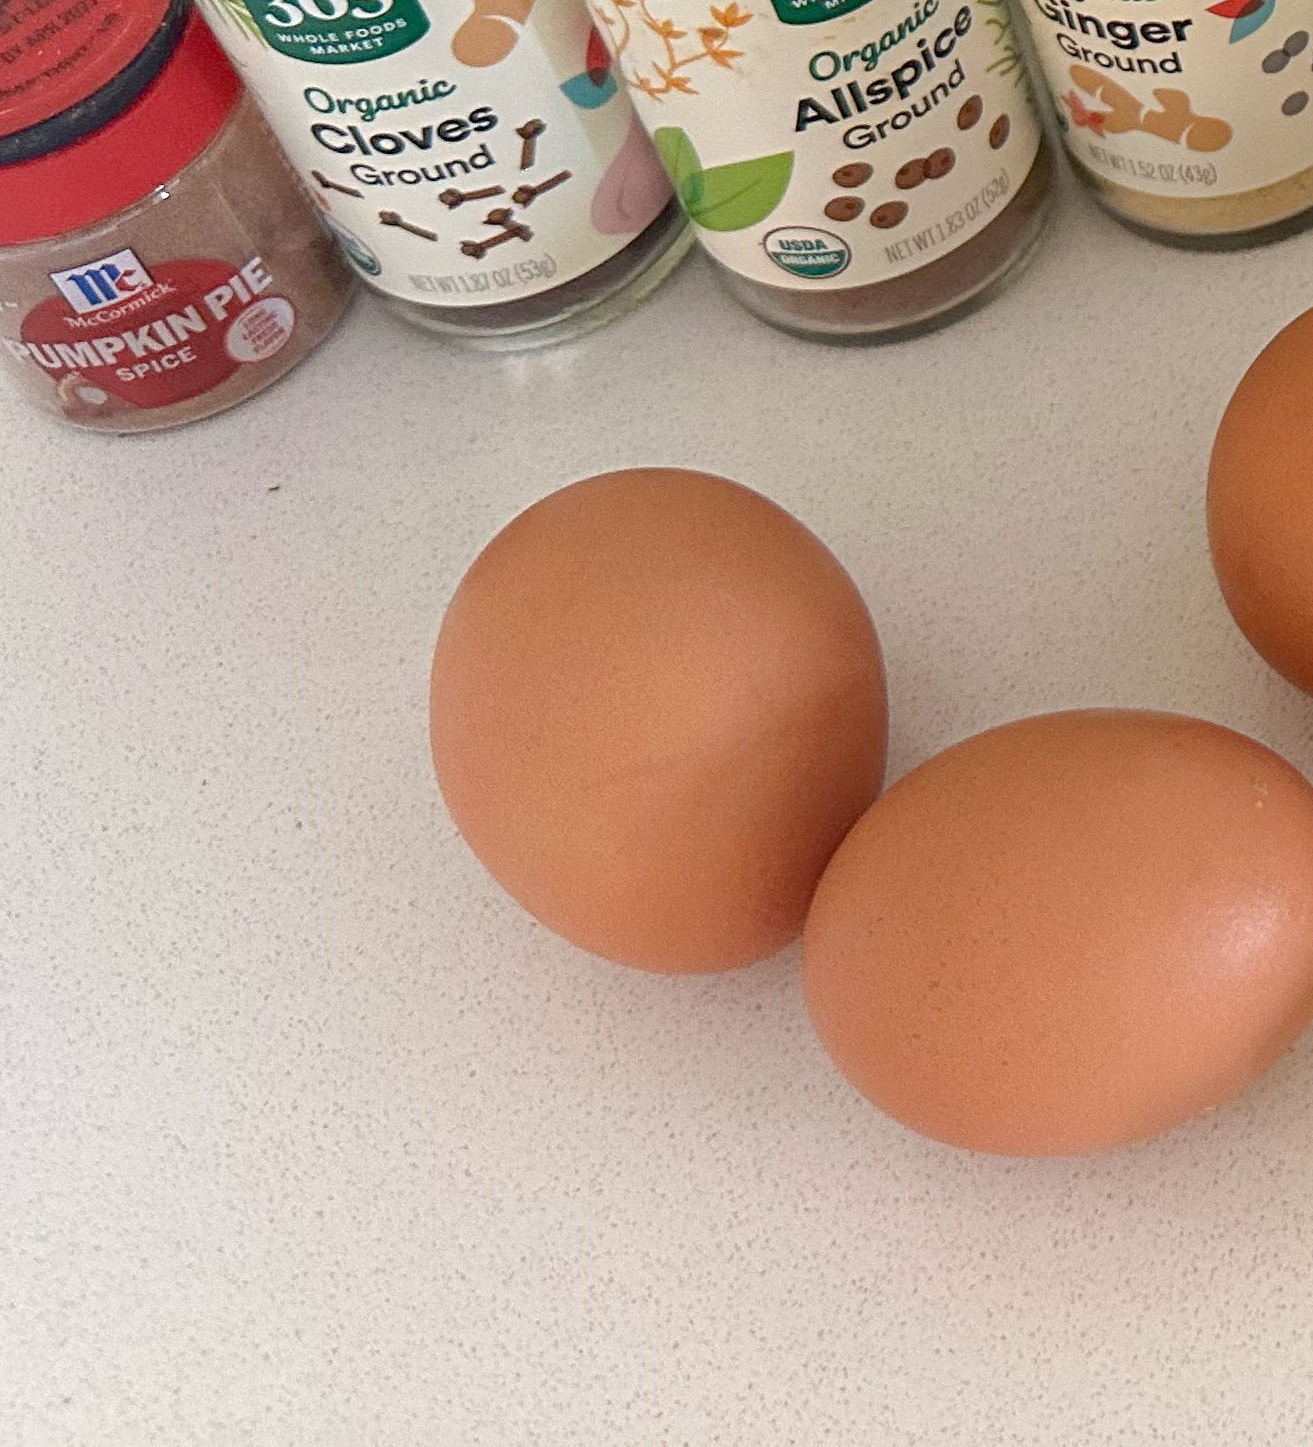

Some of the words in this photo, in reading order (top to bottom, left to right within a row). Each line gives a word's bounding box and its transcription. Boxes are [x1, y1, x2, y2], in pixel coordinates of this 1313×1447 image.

[277, 33, 339, 43] WHOLE
[345, 18, 408, 40] FOODS
[310, 37, 384, 55] MARKET
[795, 5, 973, 133] Allspice
[1056, 32, 1183, 74] Ground
[303, 79, 457, 122] Organic
[842, 58, 966, 150] Ground
[311, 106, 498, 155] Cloves
[350, 144, 496, 187] Ground
[778, 239, 828, 252] USDA
[63, 278, 176, 329] McCormick
[204, 256, 272, 320] PIE
[116, 346, 197, 382] SPICE
